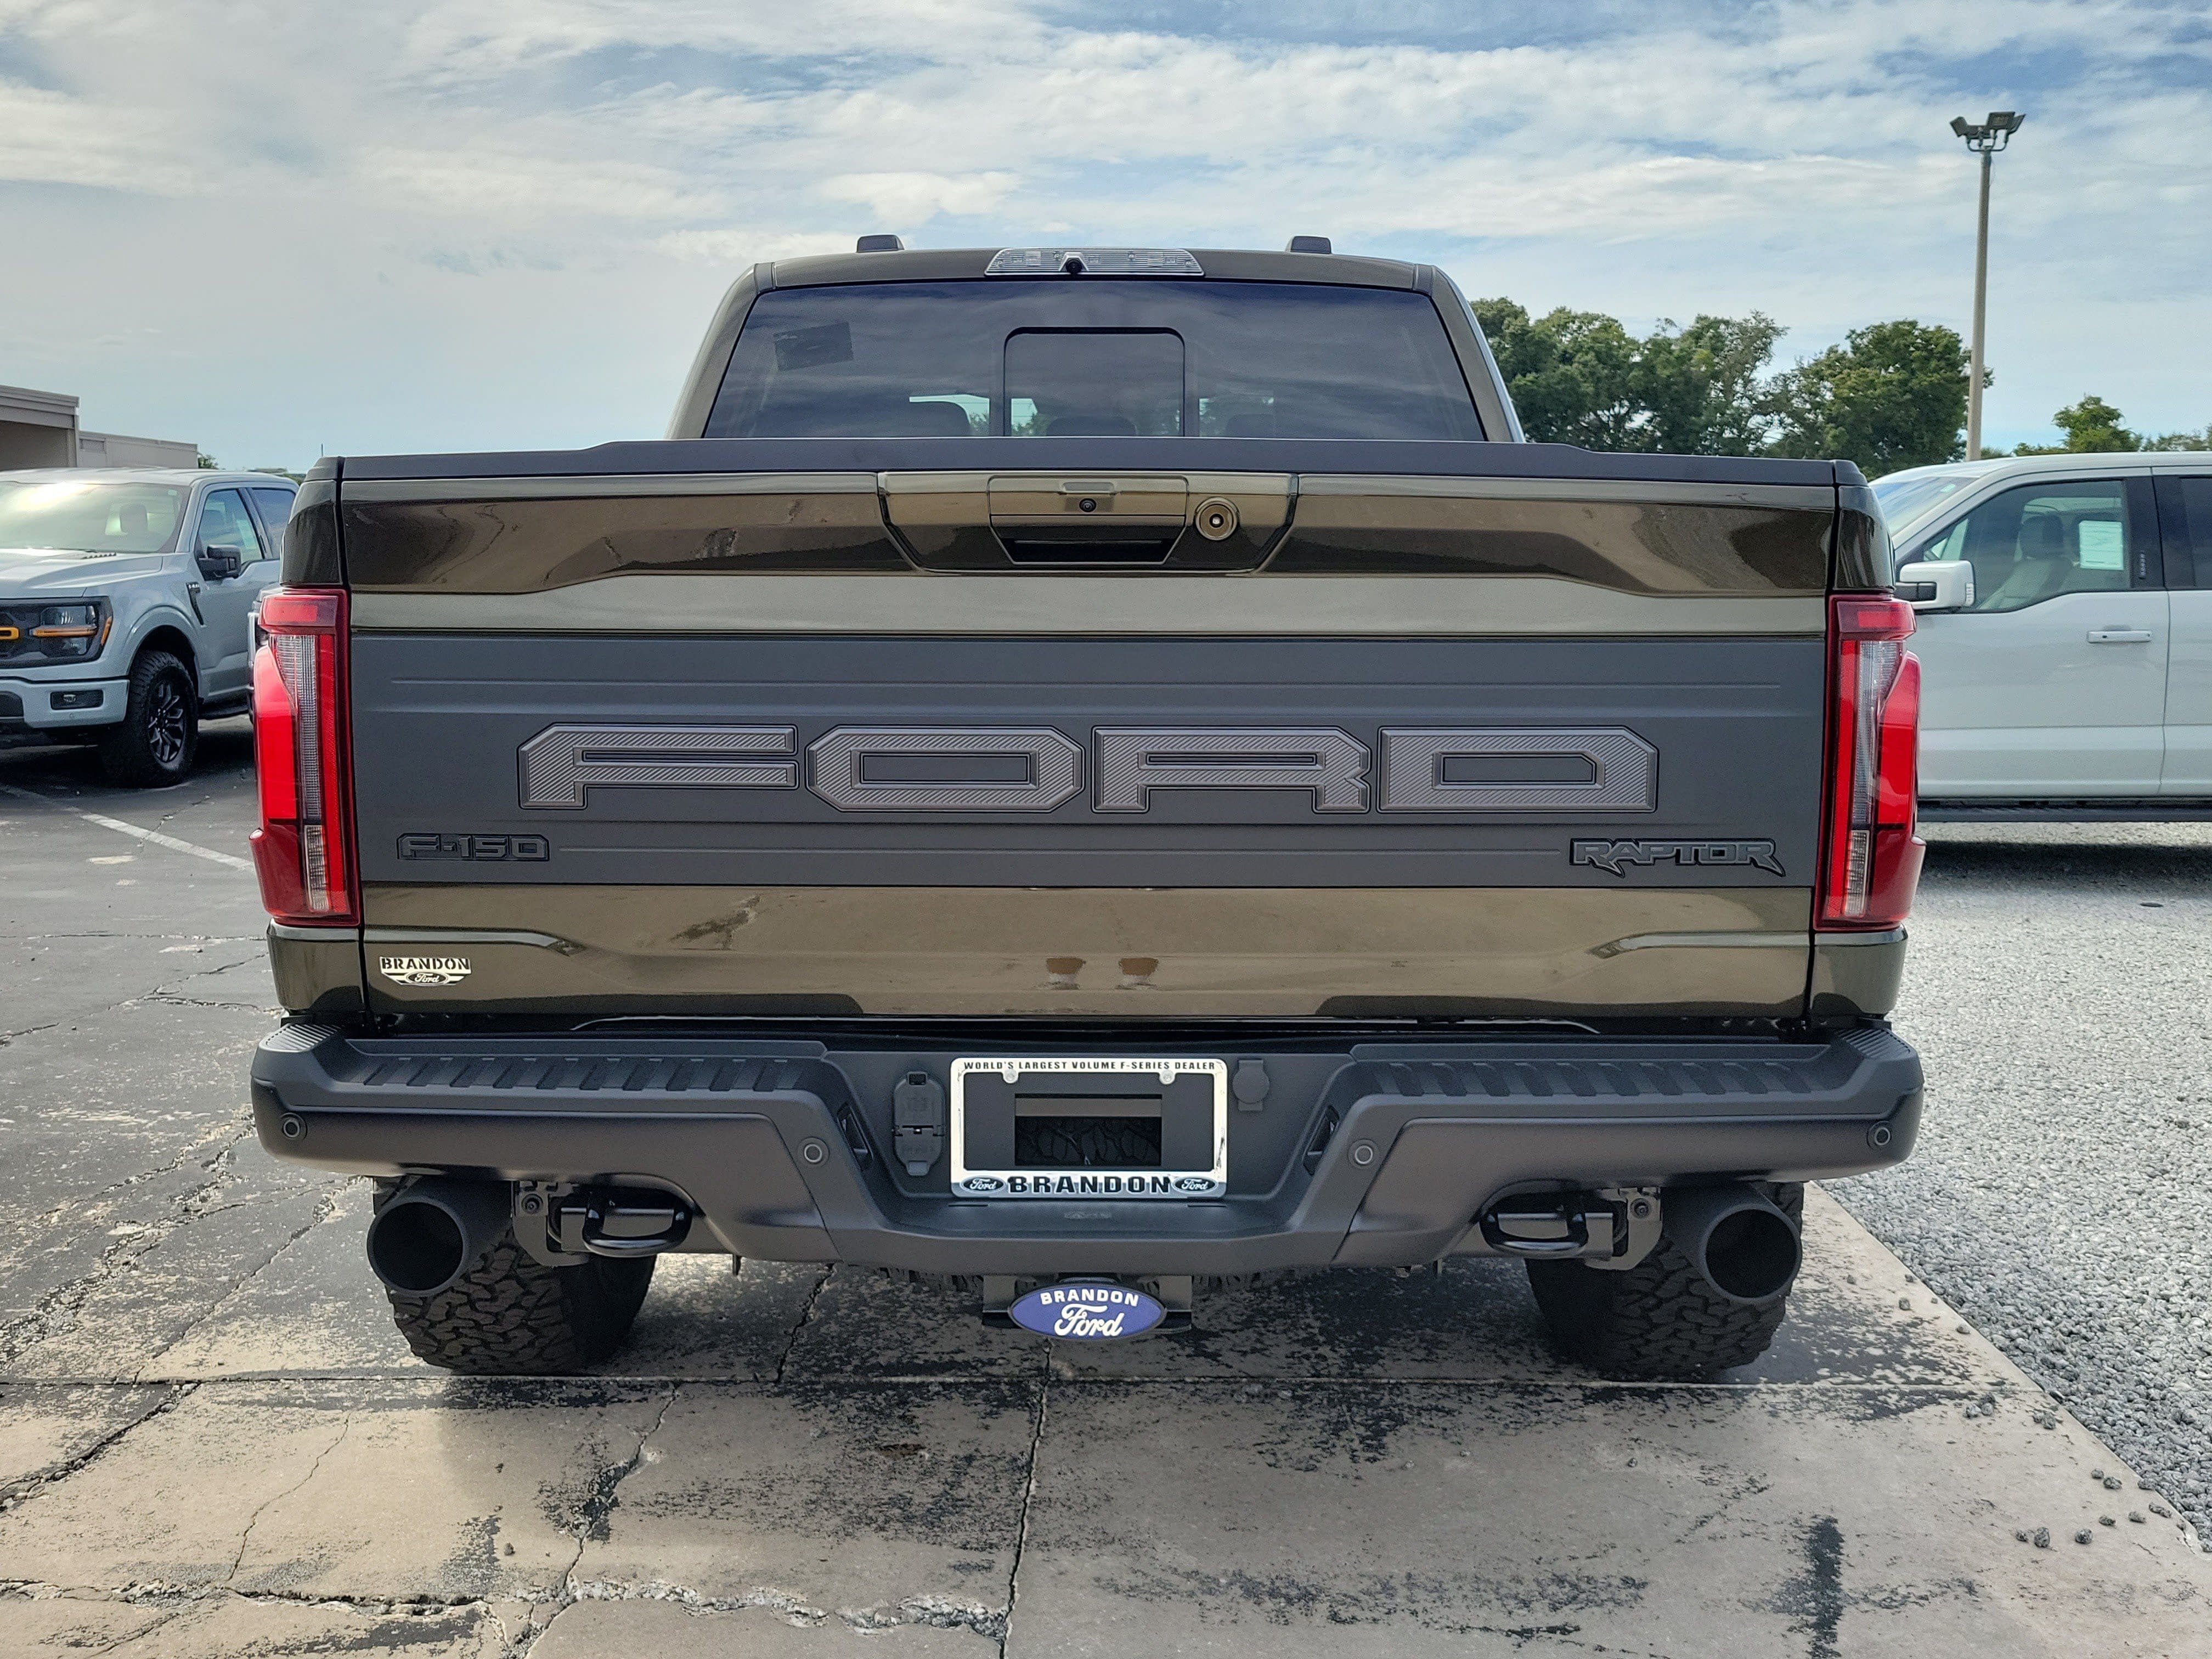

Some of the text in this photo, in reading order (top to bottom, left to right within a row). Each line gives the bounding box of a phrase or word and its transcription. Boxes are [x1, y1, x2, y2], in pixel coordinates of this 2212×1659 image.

[517, 725, 1657, 814] FORD
[398, 833, 549, 861] F-150
[1570, 838, 1786, 877] RAPTOR
[382, 958, 470, 970] BRANDON
[414, 973, 440, 983] Ford
[969, 1176, 1208, 1193] Ford BRANDON Ford
[1040, 1289, 1139, 1306] BRANDON
[1054, 1303, 1125, 1336] Ford
